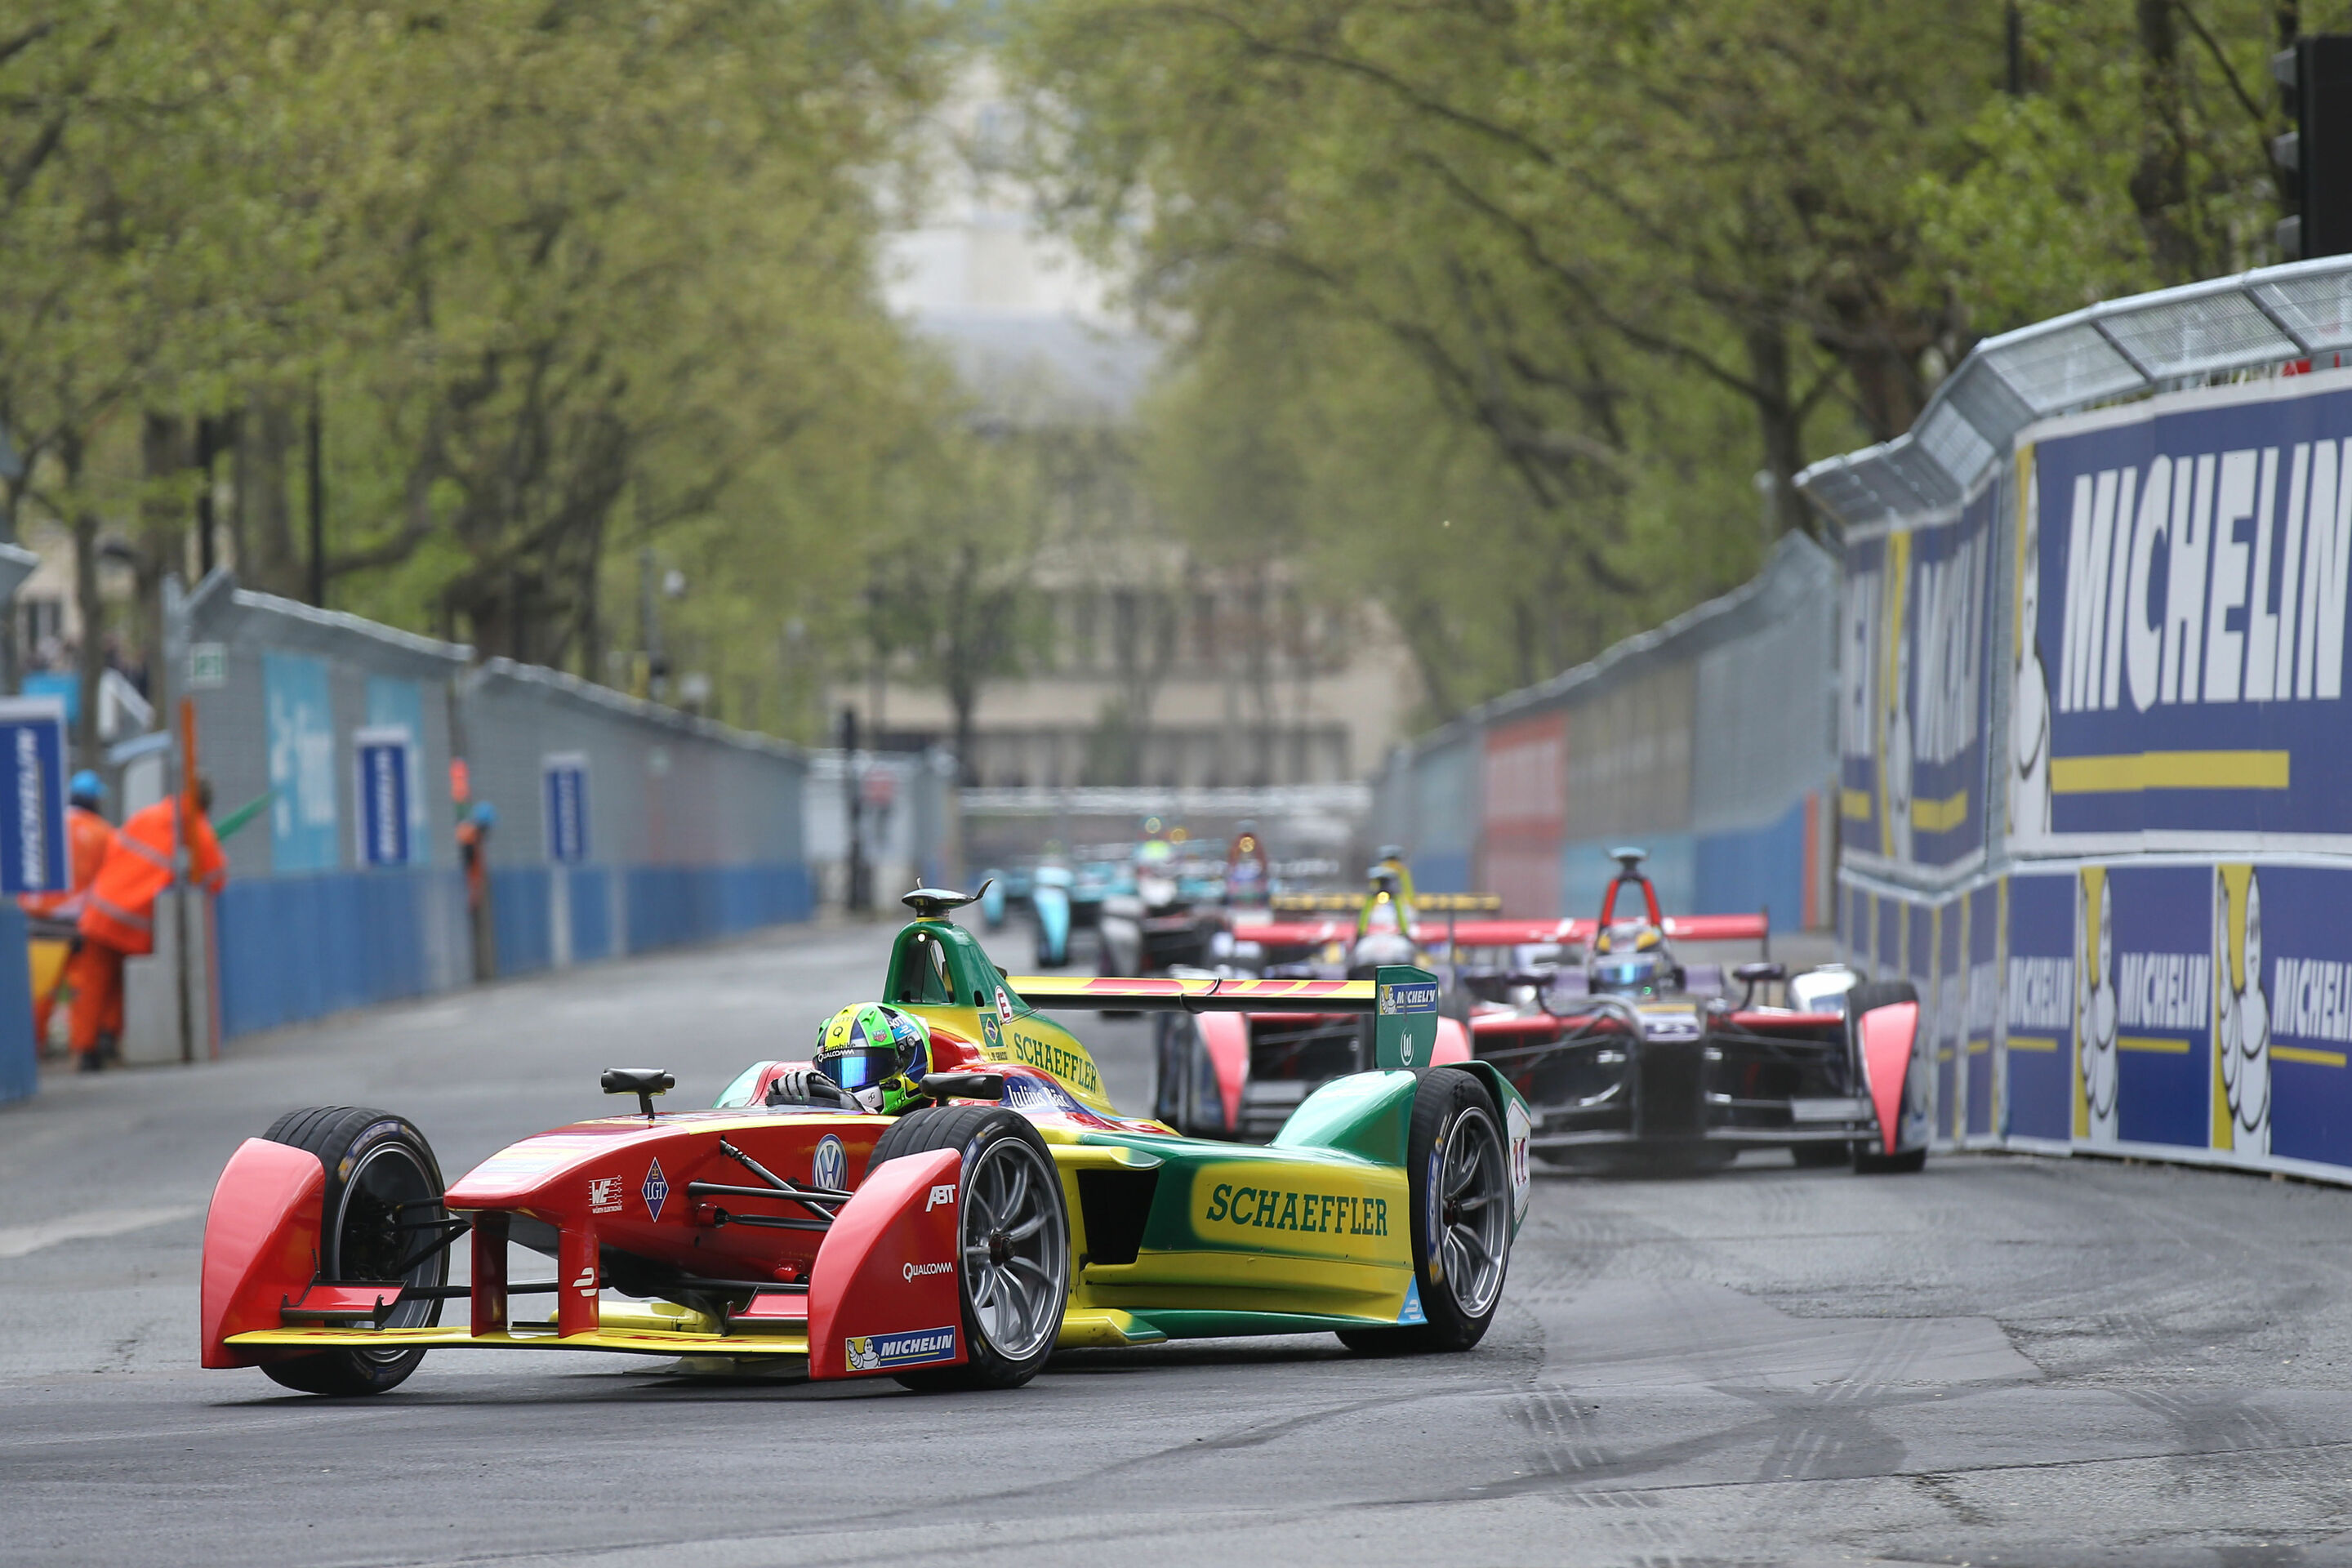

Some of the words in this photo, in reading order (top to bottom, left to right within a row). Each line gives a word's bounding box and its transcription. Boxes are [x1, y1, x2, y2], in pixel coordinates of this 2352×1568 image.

[2060, 434, 2352, 715] MICHELIN
[997, 993, 1010, 1018] E
[1397, 990, 1436, 1004] MCHELIN
[2008, 956, 2074, 1030] MICHELIN
[2118, 952, 2211, 1030] MICHELIN
[2272, 956, 2352, 1043] MICHELI
[1013, 1032, 1097, 1094] SCHAEFFLER
[1006, 1085, 1043, 1109] Julius
[646, 1182, 665, 1200] LGT
[925, 1184, 956, 1212] ABT
[1206, 1183, 1388, 1236] SCHAEFFLER
[880, 1334, 953, 1356] MICHELIN
